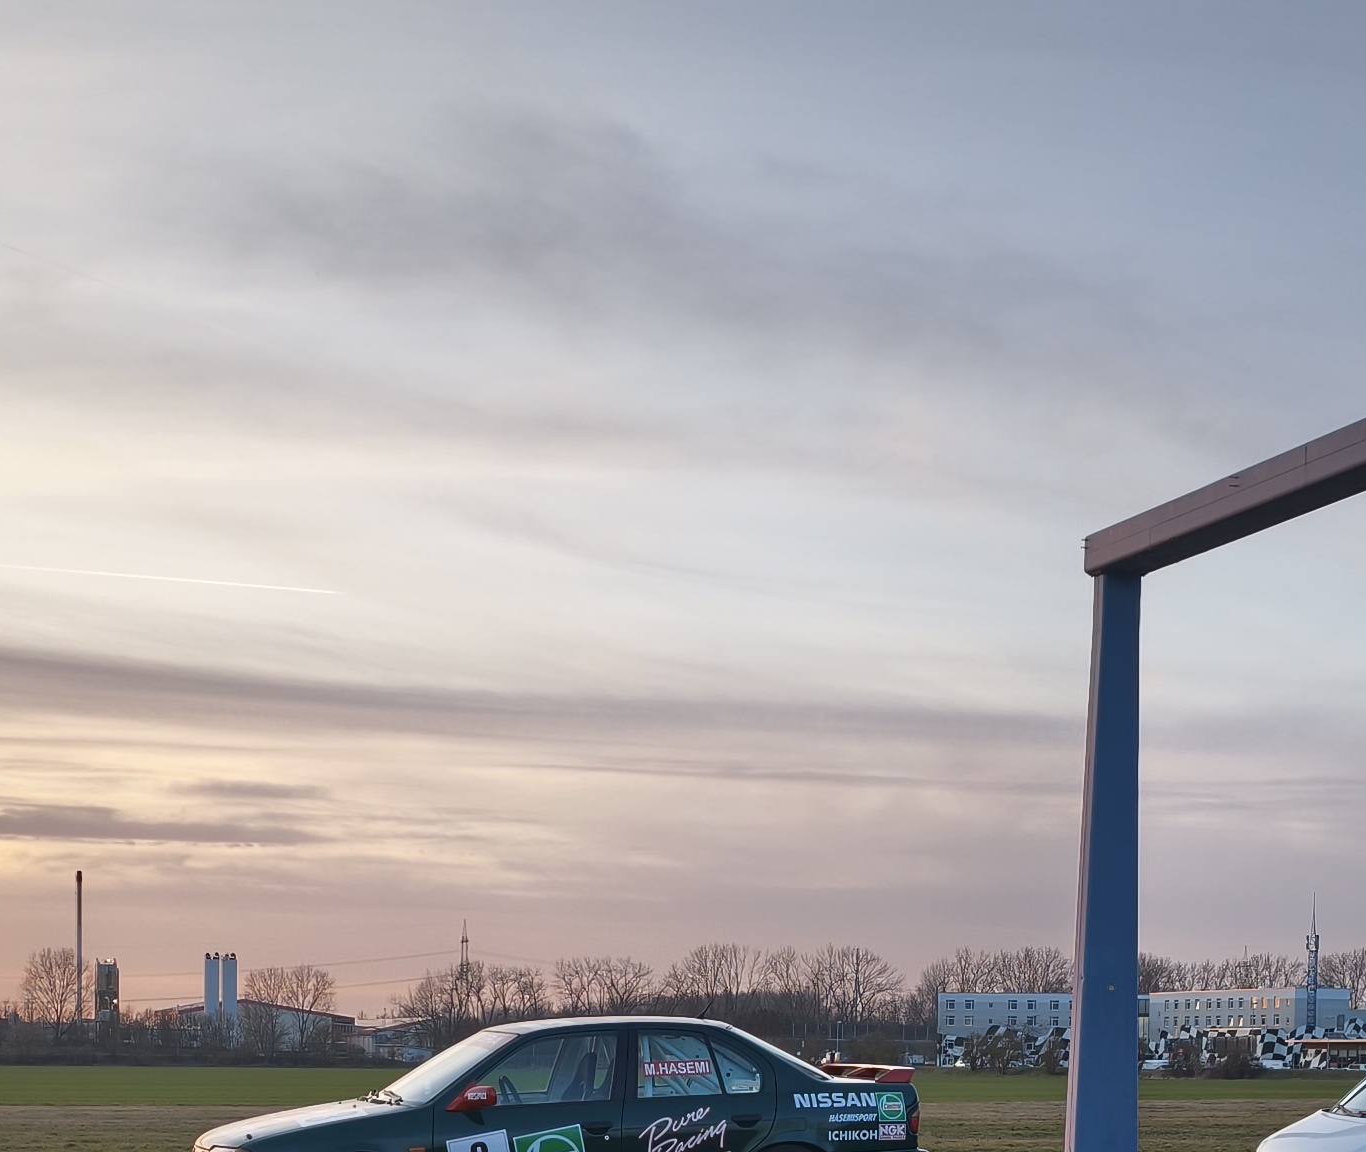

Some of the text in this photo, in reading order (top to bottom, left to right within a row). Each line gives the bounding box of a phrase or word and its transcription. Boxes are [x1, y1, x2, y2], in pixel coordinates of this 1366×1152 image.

[644, 1061, 710, 1076] M.HASEMI
[793, 1092, 878, 1108] NISSAN
[828, 1129, 878, 1141] ICHIKOH
[879, 1124, 905, 1136] NGK
